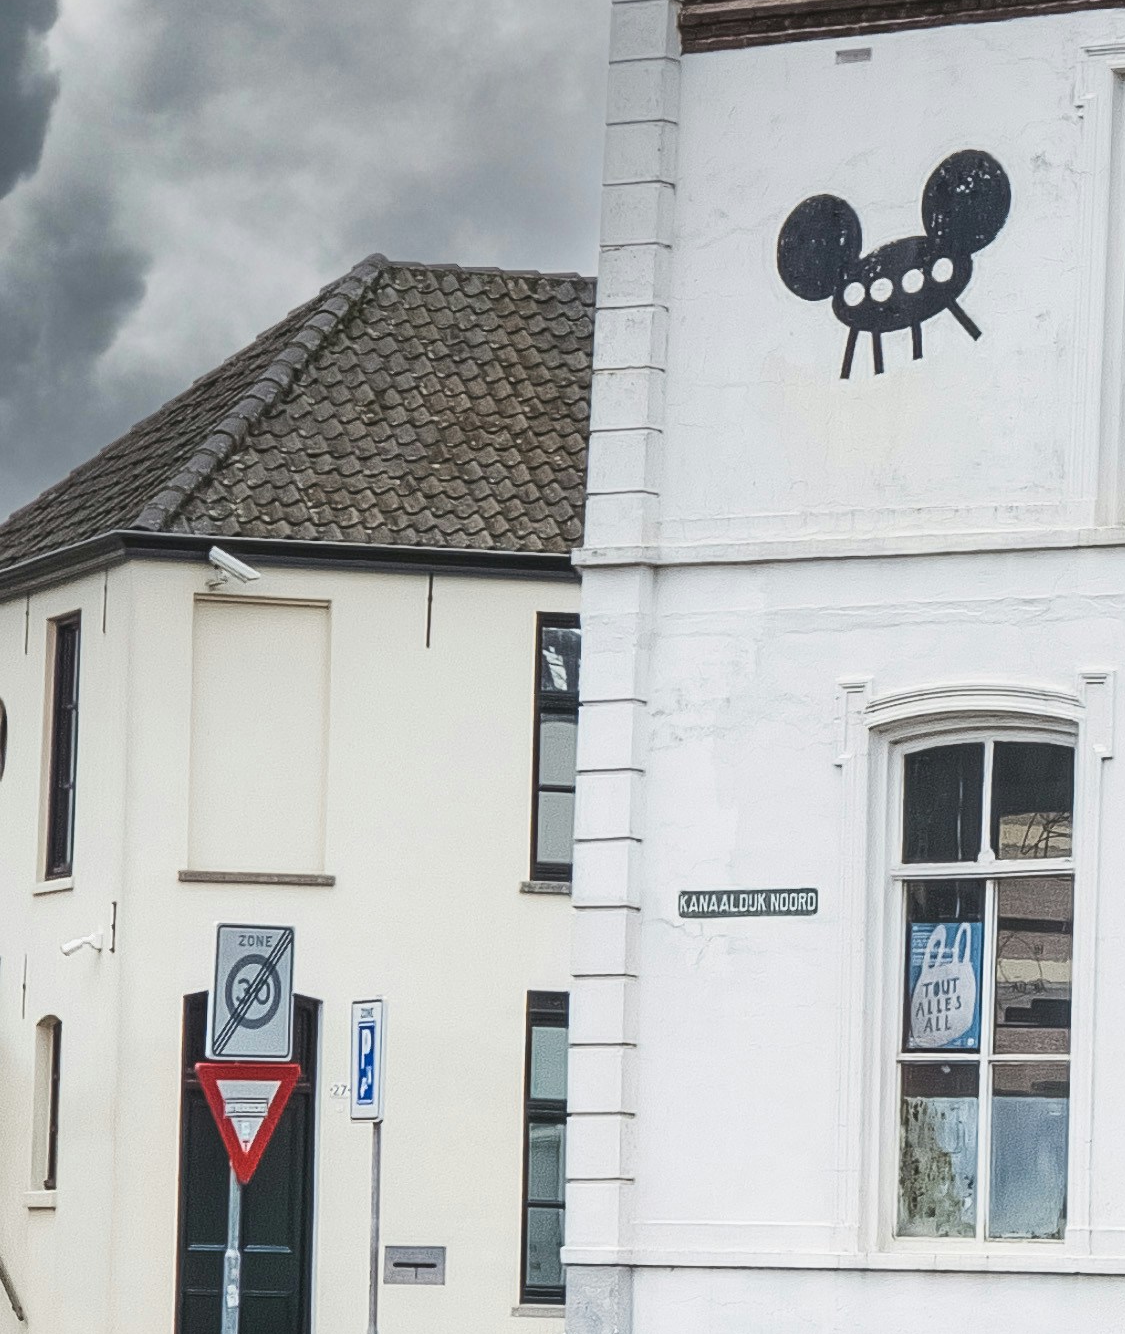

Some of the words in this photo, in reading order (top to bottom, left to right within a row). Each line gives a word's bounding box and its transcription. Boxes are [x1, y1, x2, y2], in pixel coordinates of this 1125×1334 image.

[770, 892, 817, 911] NOORD
[238, 934, 273, 947] ZONE
[237, 978, 271, 1005] 30
[922, 977, 959, 997] TOUT
[916, 995, 962, 1017] ALLES
[924, 1014, 951, 1034] ALL
[361, 1028, 372, 1069] P
